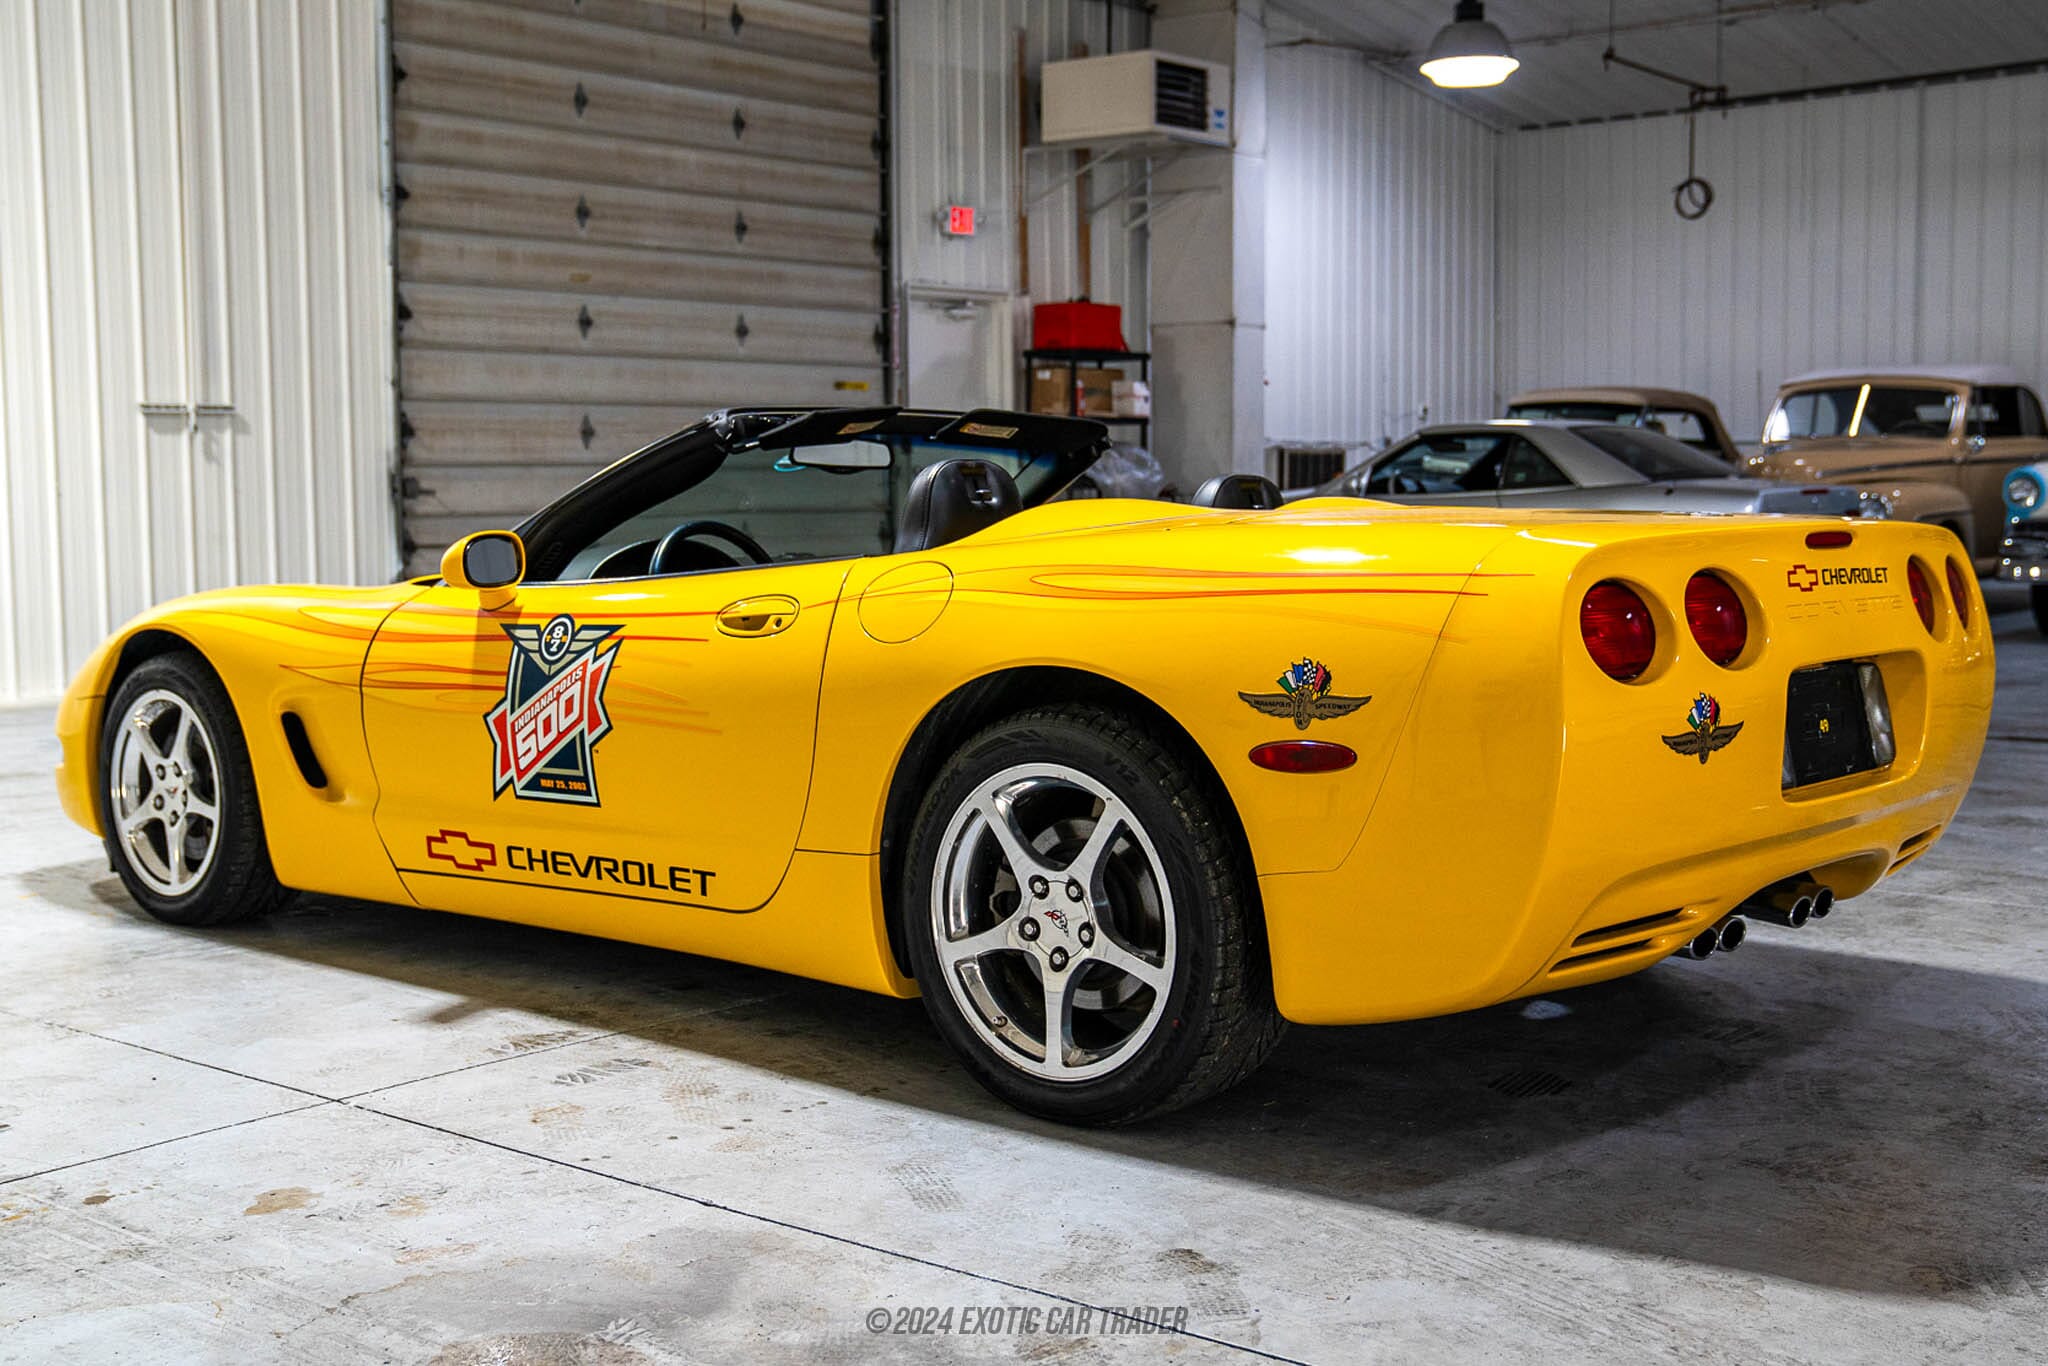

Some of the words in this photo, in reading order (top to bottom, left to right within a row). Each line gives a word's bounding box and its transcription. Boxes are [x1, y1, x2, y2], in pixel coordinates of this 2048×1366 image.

[1821, 567, 1888, 586] CHEVROLET
[514, 665, 584, 732] INDIANAPOLIS
[515, 680, 582, 771] 500
[568, 780, 587, 791] 2003
[506, 845, 716, 897] CHEVROLET
